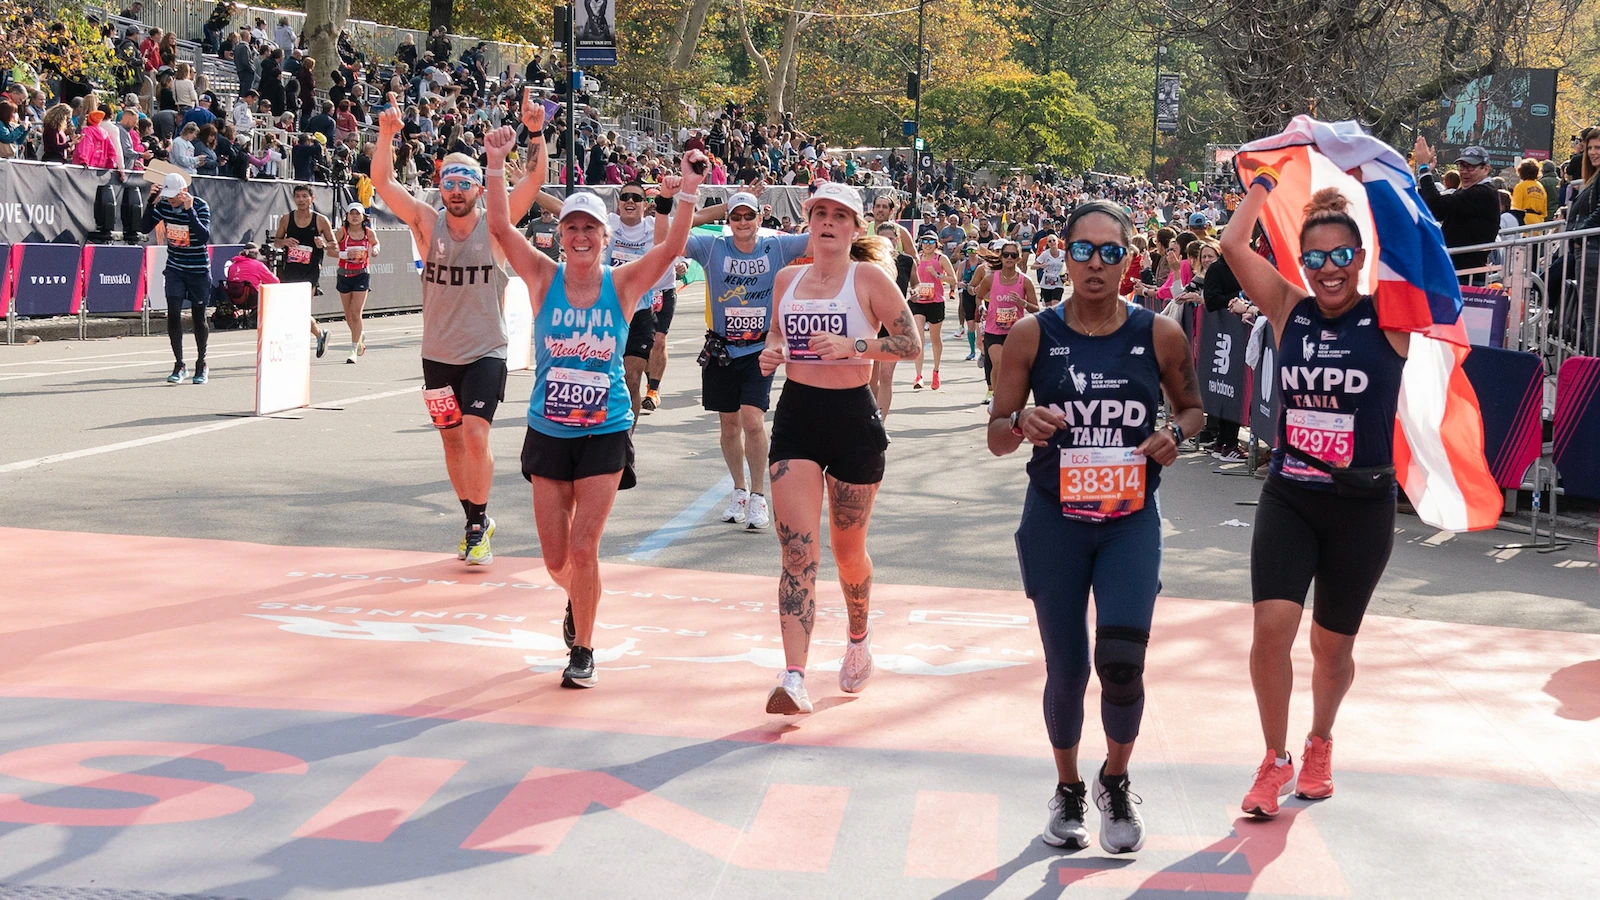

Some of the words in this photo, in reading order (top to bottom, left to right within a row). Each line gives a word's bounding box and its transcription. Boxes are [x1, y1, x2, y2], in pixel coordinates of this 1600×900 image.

[922, 156, 931, 167] G
[26, 204, 54, 225] YOU
[425, 262, 493, 286] SCOTT
[730, 259, 766, 275] ROBB
[31, 276, 67, 285] VOLVO
[726, 317, 764, 329] 20988
[787, 314, 843, 335] 50019
[1294, 315, 1311, 326] 2023
[1050, 346, 1070, 356] 2023
[1208, 380, 1216, 393] new
[1217, 379, 1234, 398] balance
[1281, 366, 1369, 393] NYPD
[547, 381, 607, 406] 24807
[1293, 395, 1339, 409] TANIA
[1048, 400, 1147, 427] NYPD
[1070, 427, 1123, 447] TANIA
[1290, 427, 1348, 455] 42975
[1072, 453, 1089, 464] tcs
[1067, 467, 1140, 493] 38314
[285, 572, 459, 586] MAJORS
[256, 602, 526, 624] RUNNERS
